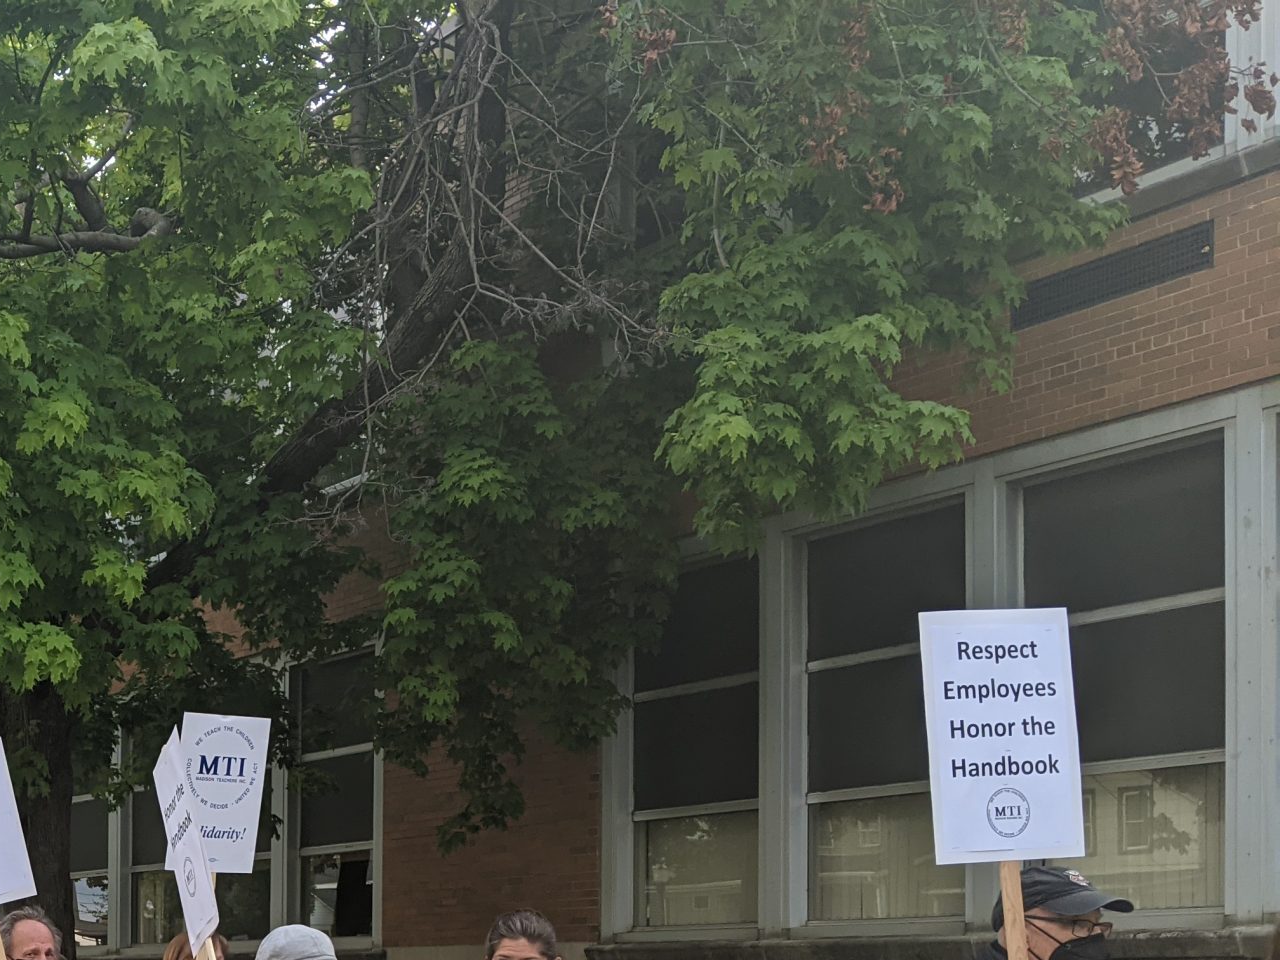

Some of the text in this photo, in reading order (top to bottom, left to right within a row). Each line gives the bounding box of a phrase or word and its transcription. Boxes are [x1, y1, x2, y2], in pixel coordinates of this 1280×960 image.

[957, 640, 1038, 664] Respect
[943, 678, 1057, 703] Employees
[204, 725, 221, 738] TEACH
[235, 728, 255, 751] CHILDREN
[950, 716, 1056, 739] Honor the
[197, 754, 247, 777] MTI
[951, 754, 1060, 778] Handbook
[994, 805, 1021, 817] MTI
[200, 825, 247, 843] lidarity!
